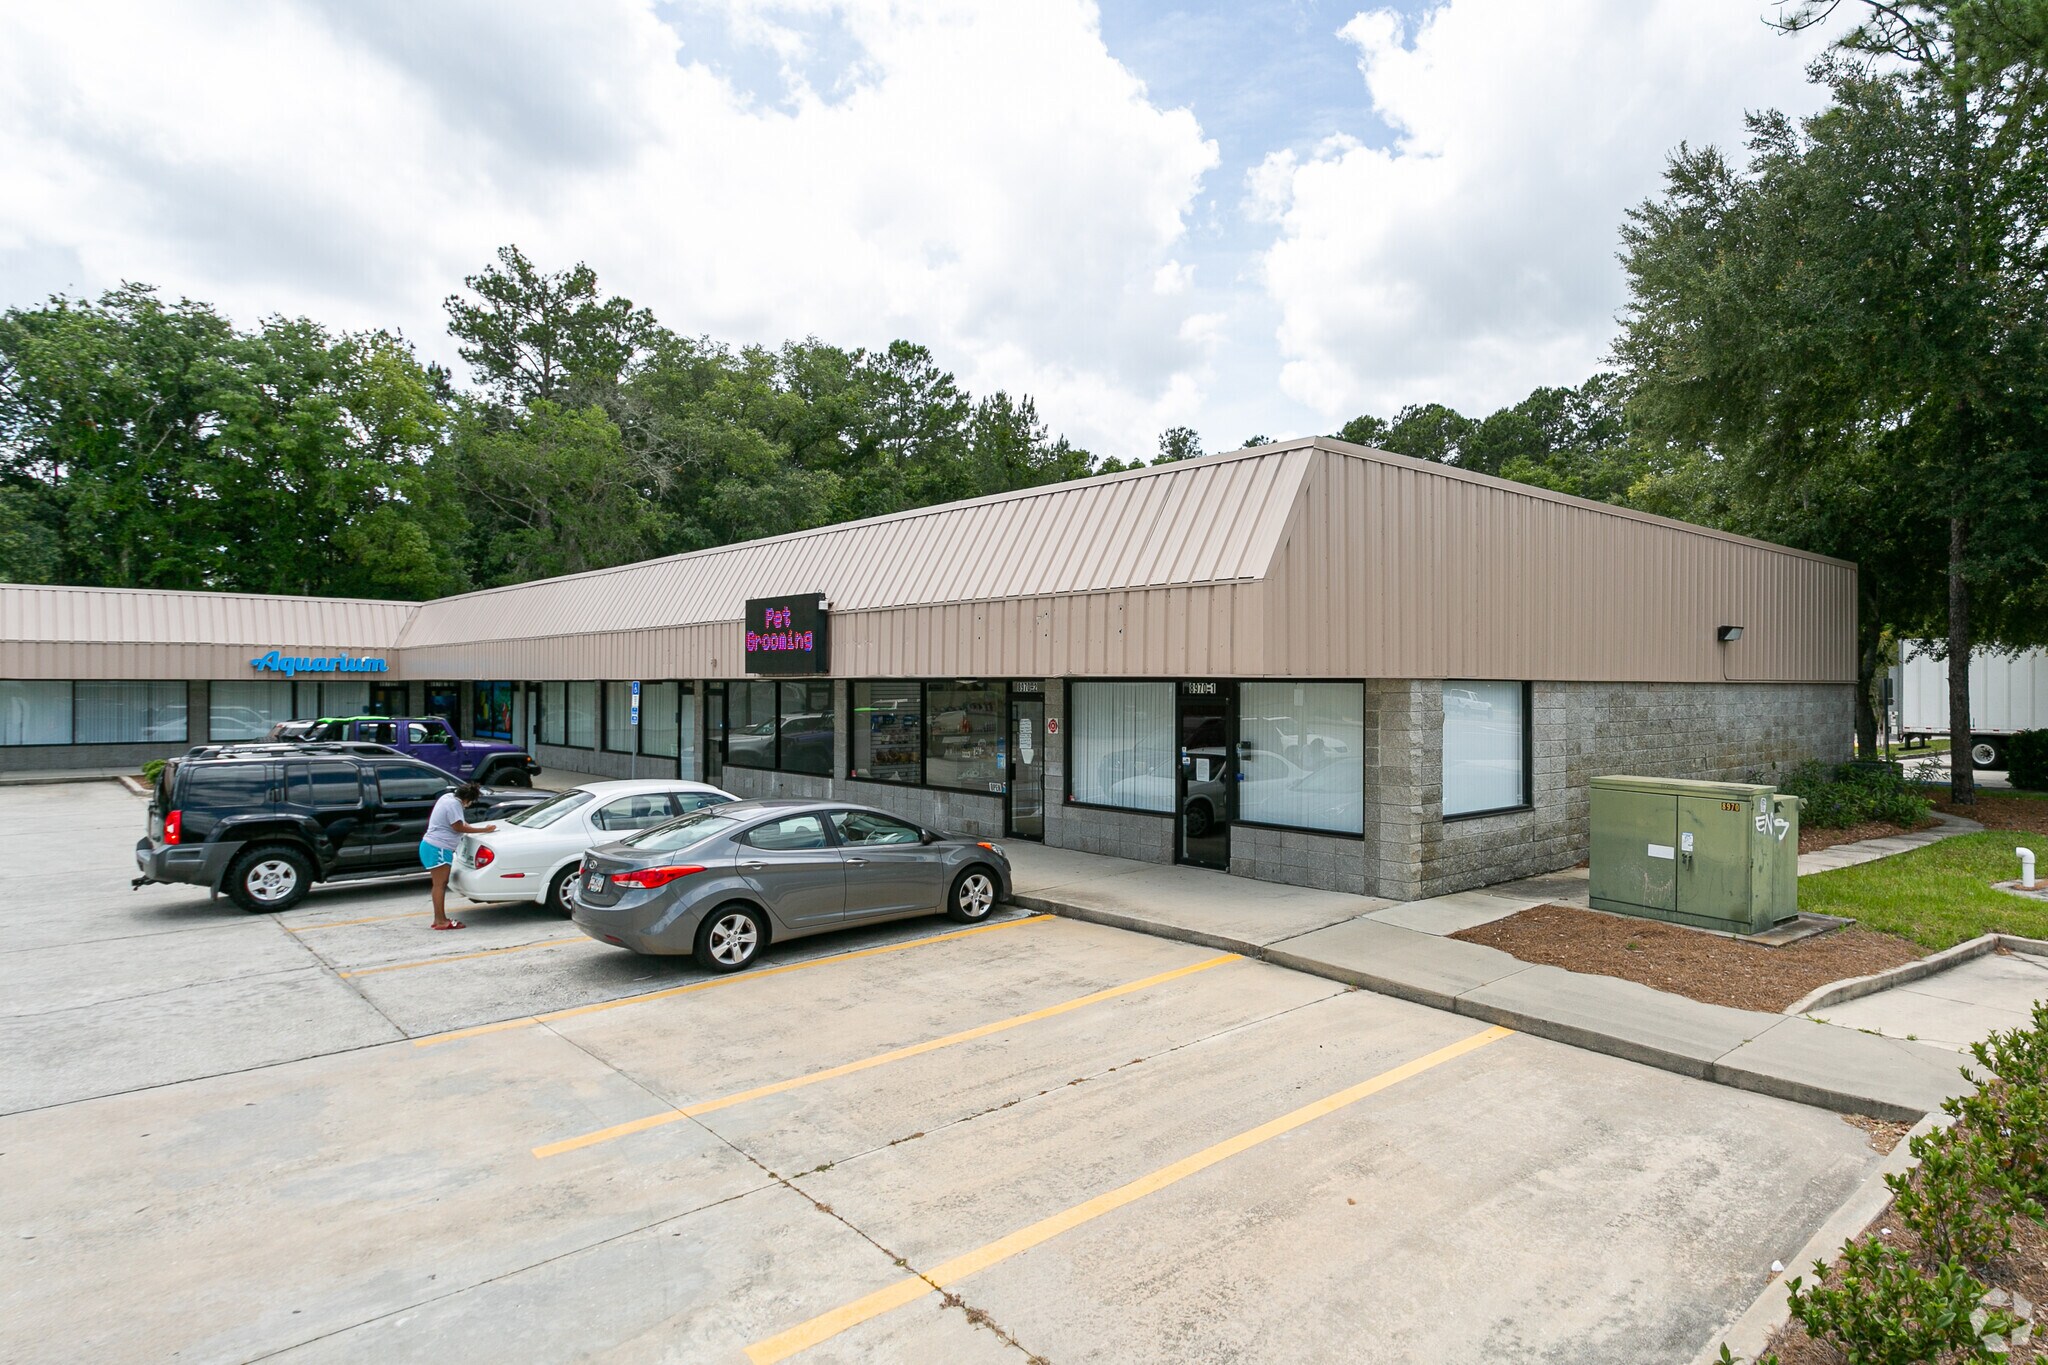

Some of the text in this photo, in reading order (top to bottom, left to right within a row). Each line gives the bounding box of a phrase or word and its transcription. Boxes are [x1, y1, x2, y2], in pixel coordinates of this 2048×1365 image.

[765, 605, 791, 629] Pet
[746, 629, 813, 652] Grooming
[250, 650, 390, 677] Aquarium
[1721, 802, 1740, 812] 8970
